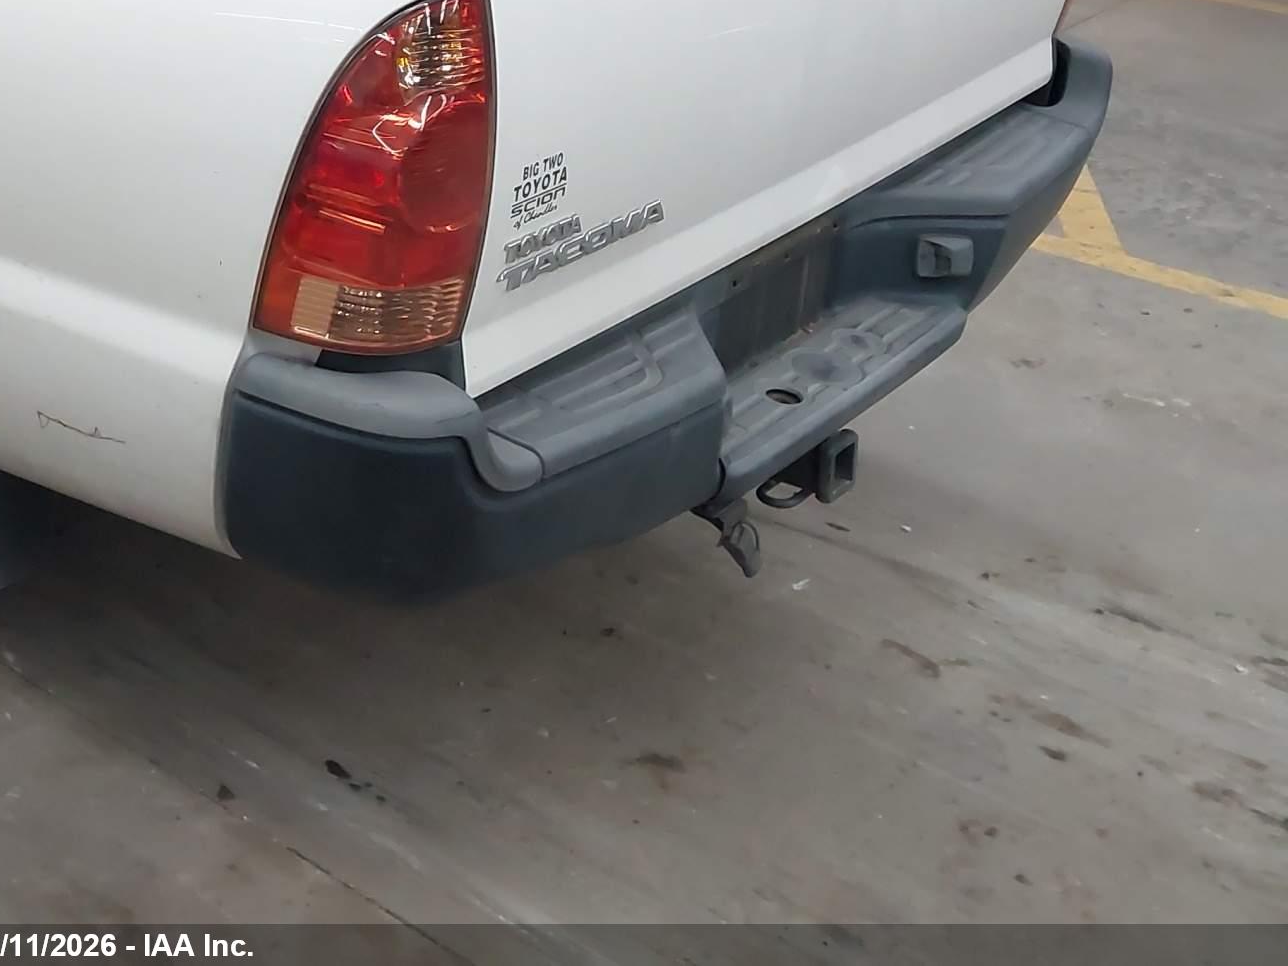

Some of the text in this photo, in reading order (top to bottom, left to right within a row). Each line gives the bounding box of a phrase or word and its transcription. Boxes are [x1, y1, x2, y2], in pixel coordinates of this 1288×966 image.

[513, 166, 567, 202] TOYOTA
[523, 152, 564, 181] BIG TWO
[496, 199, 665, 291] TACOMA
[504, 213, 582, 264] TOYOTA
